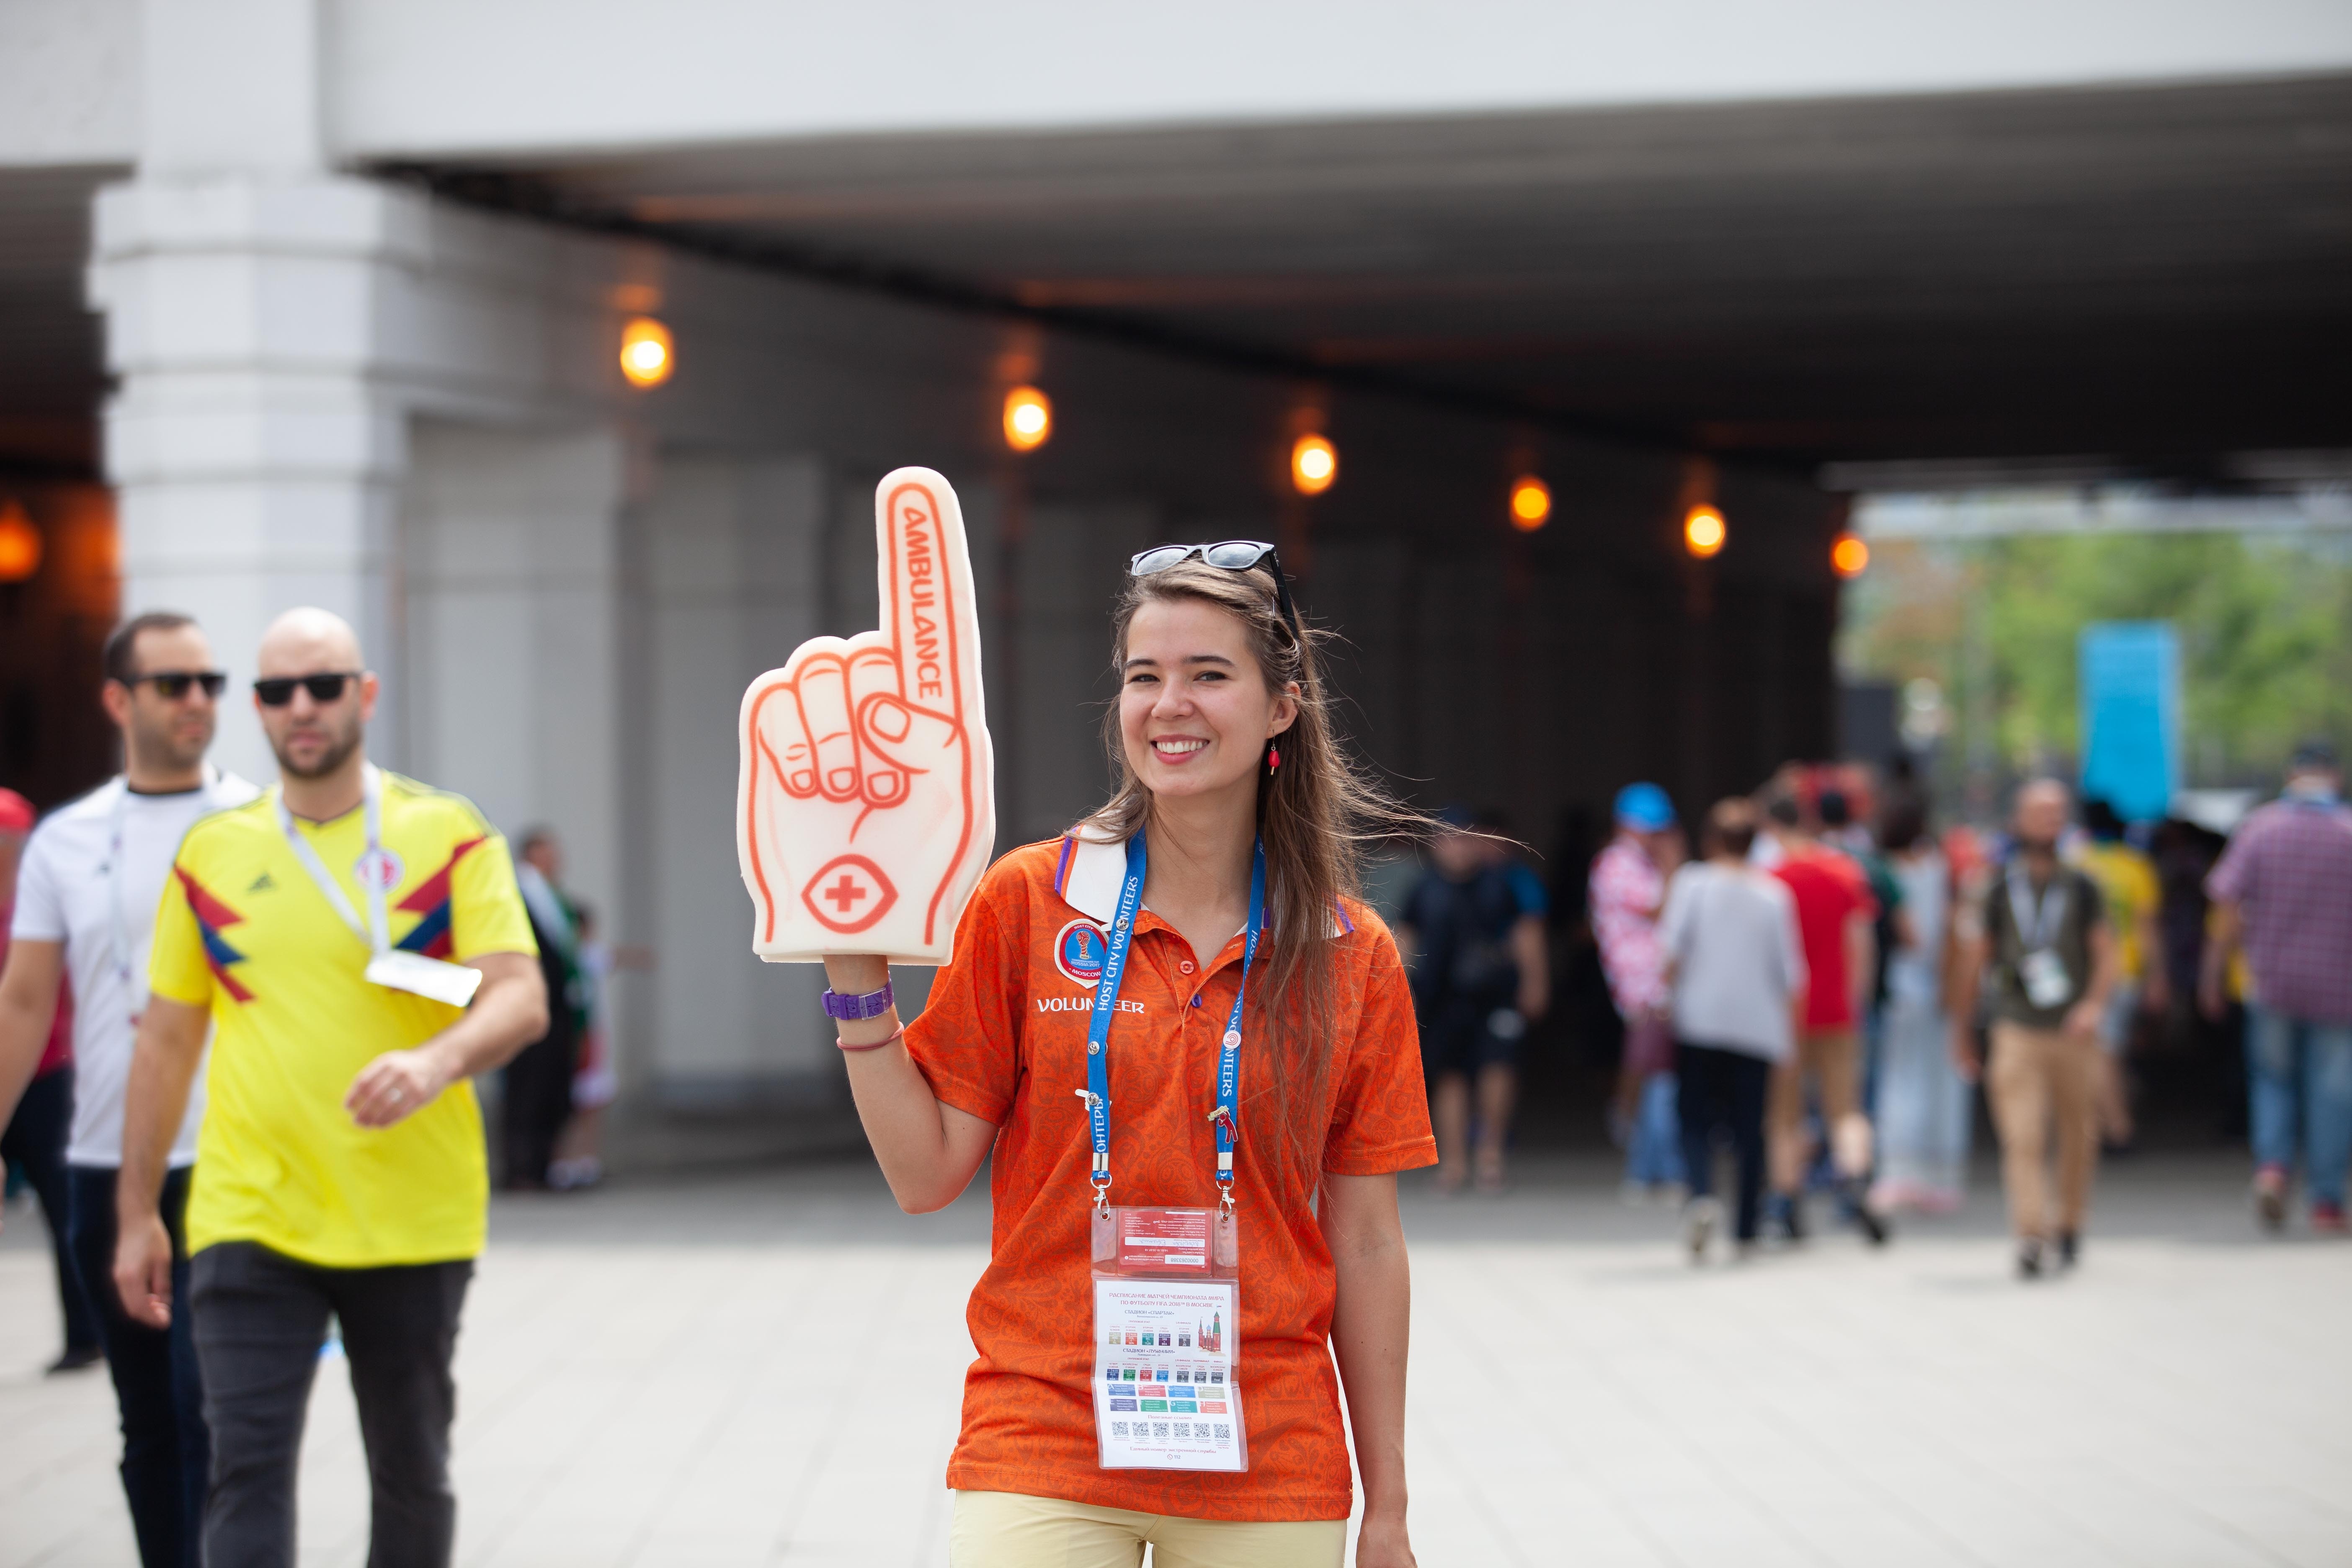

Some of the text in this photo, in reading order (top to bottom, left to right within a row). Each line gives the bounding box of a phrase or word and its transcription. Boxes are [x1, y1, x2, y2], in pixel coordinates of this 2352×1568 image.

[903, 506, 942, 699] AMBULANCE
[1072, 969, 1101, 977] MOSCOW
[1098, 875, 1138, 1011] HOST CITY VOLNTEERS
[1037, 997, 1145, 1014] VOLUNEER
